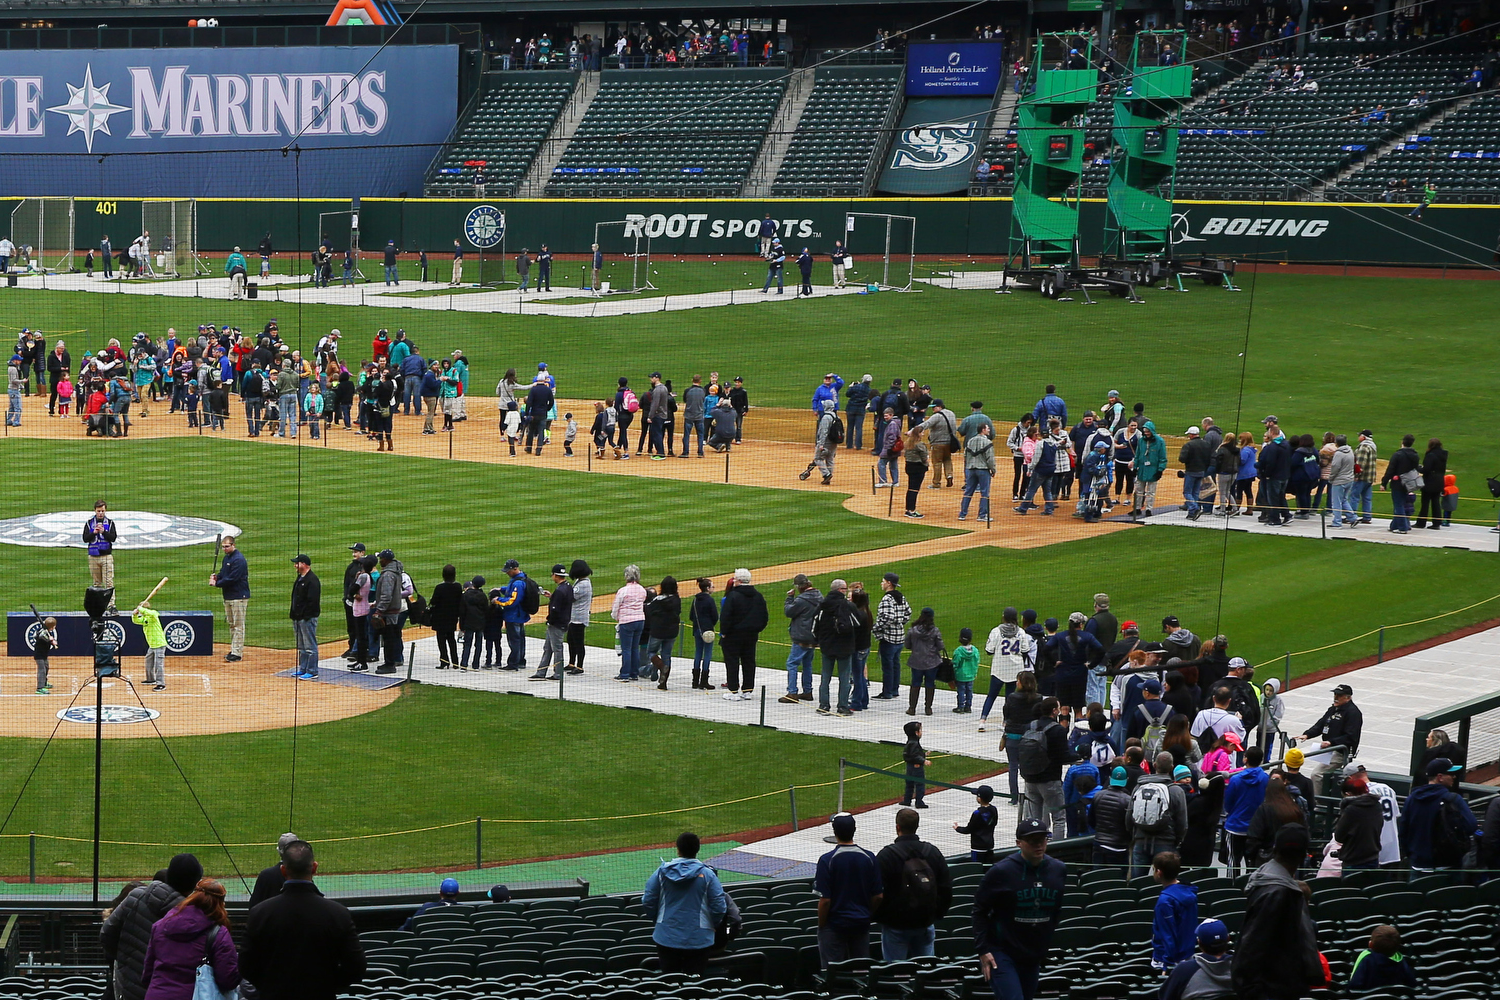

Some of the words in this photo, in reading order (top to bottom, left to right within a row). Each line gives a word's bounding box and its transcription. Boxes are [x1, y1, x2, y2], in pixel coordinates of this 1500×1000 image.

[128, 65, 388, 138] MARINERS
[95, 201, 117, 216] 401
[623, 213, 708, 239] ROOT
[1200, 217, 1330, 238] BOEING
[1001, 639, 1020, 656] 24
[1016, 887, 1059, 901] SEATTLE
